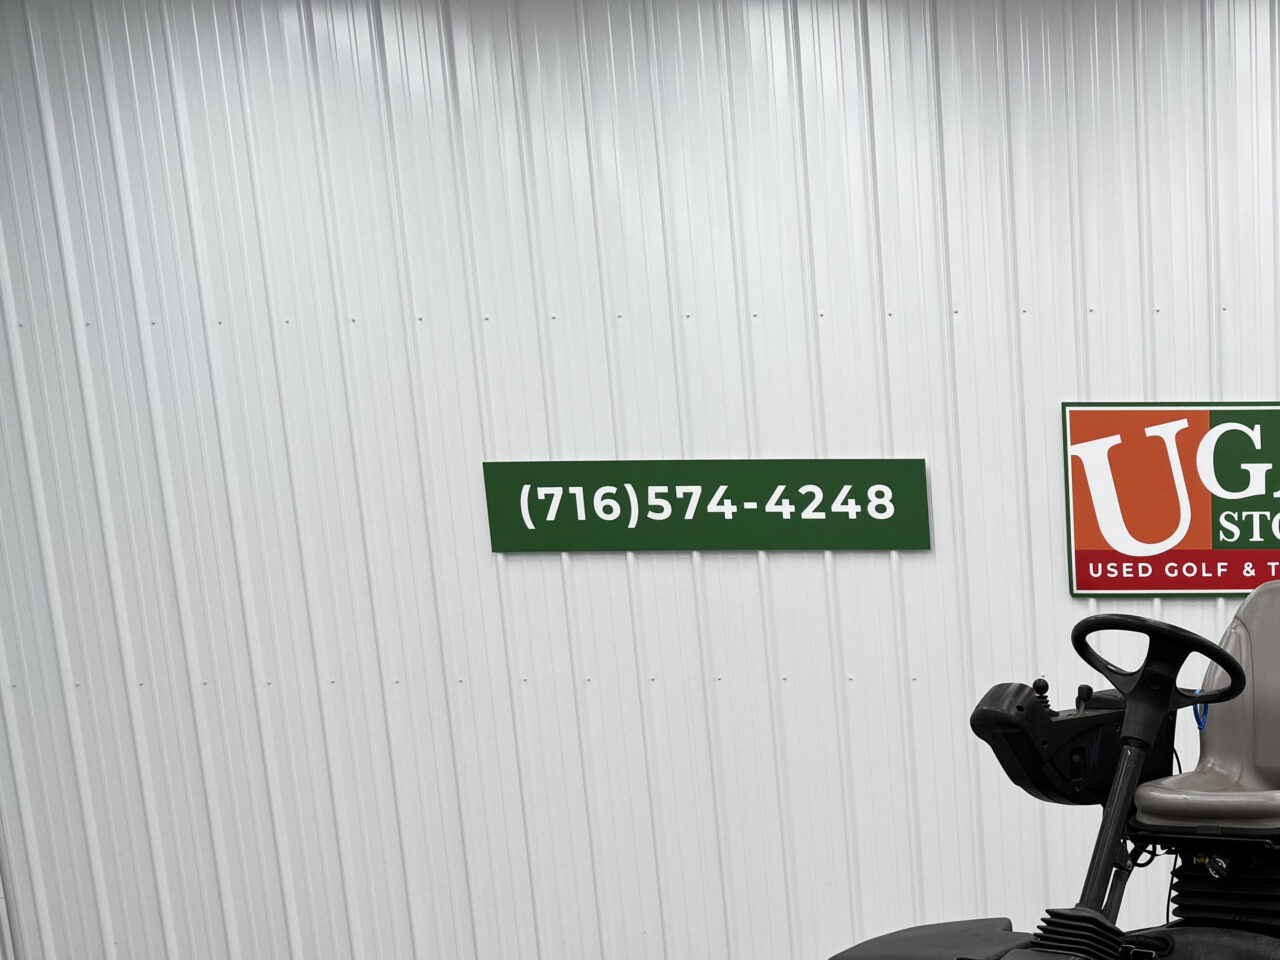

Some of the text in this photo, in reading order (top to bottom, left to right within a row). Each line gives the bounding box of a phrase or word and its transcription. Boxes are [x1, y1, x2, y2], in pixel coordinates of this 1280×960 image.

[520, 484, 896, 530] (716)574-4248
[1088, 562, 1153, 578] USED
[1164, 562, 1229, 577] GOLF
[1242, 561, 1256, 577] &
